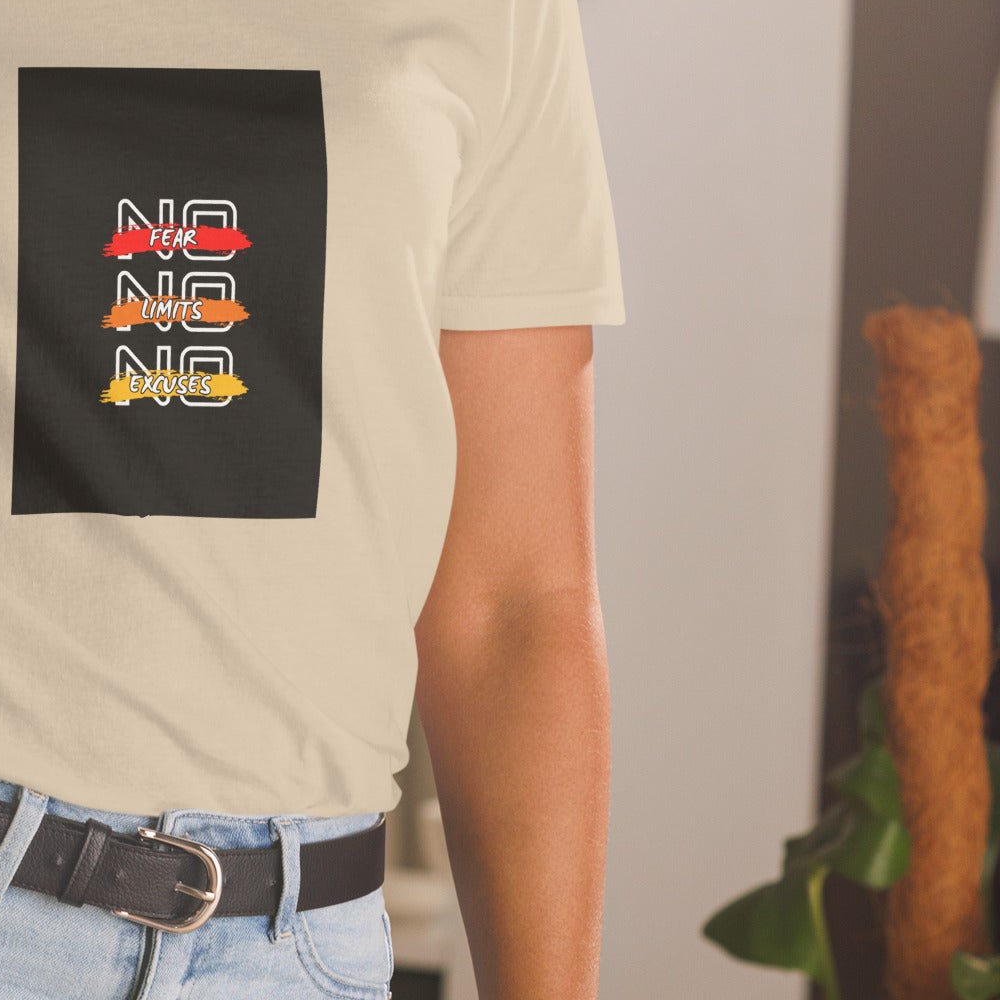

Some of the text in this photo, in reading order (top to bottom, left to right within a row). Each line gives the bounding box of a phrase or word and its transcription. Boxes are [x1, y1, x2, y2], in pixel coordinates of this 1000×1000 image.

[117, 198, 238, 261] NO
[149, 228, 198, 248] FEAR
[116, 270, 236, 332] NO
[141, 298, 204, 321] LIMITS
[115, 345, 234, 407] NO
[129, 375, 212, 395] EXCUSES
